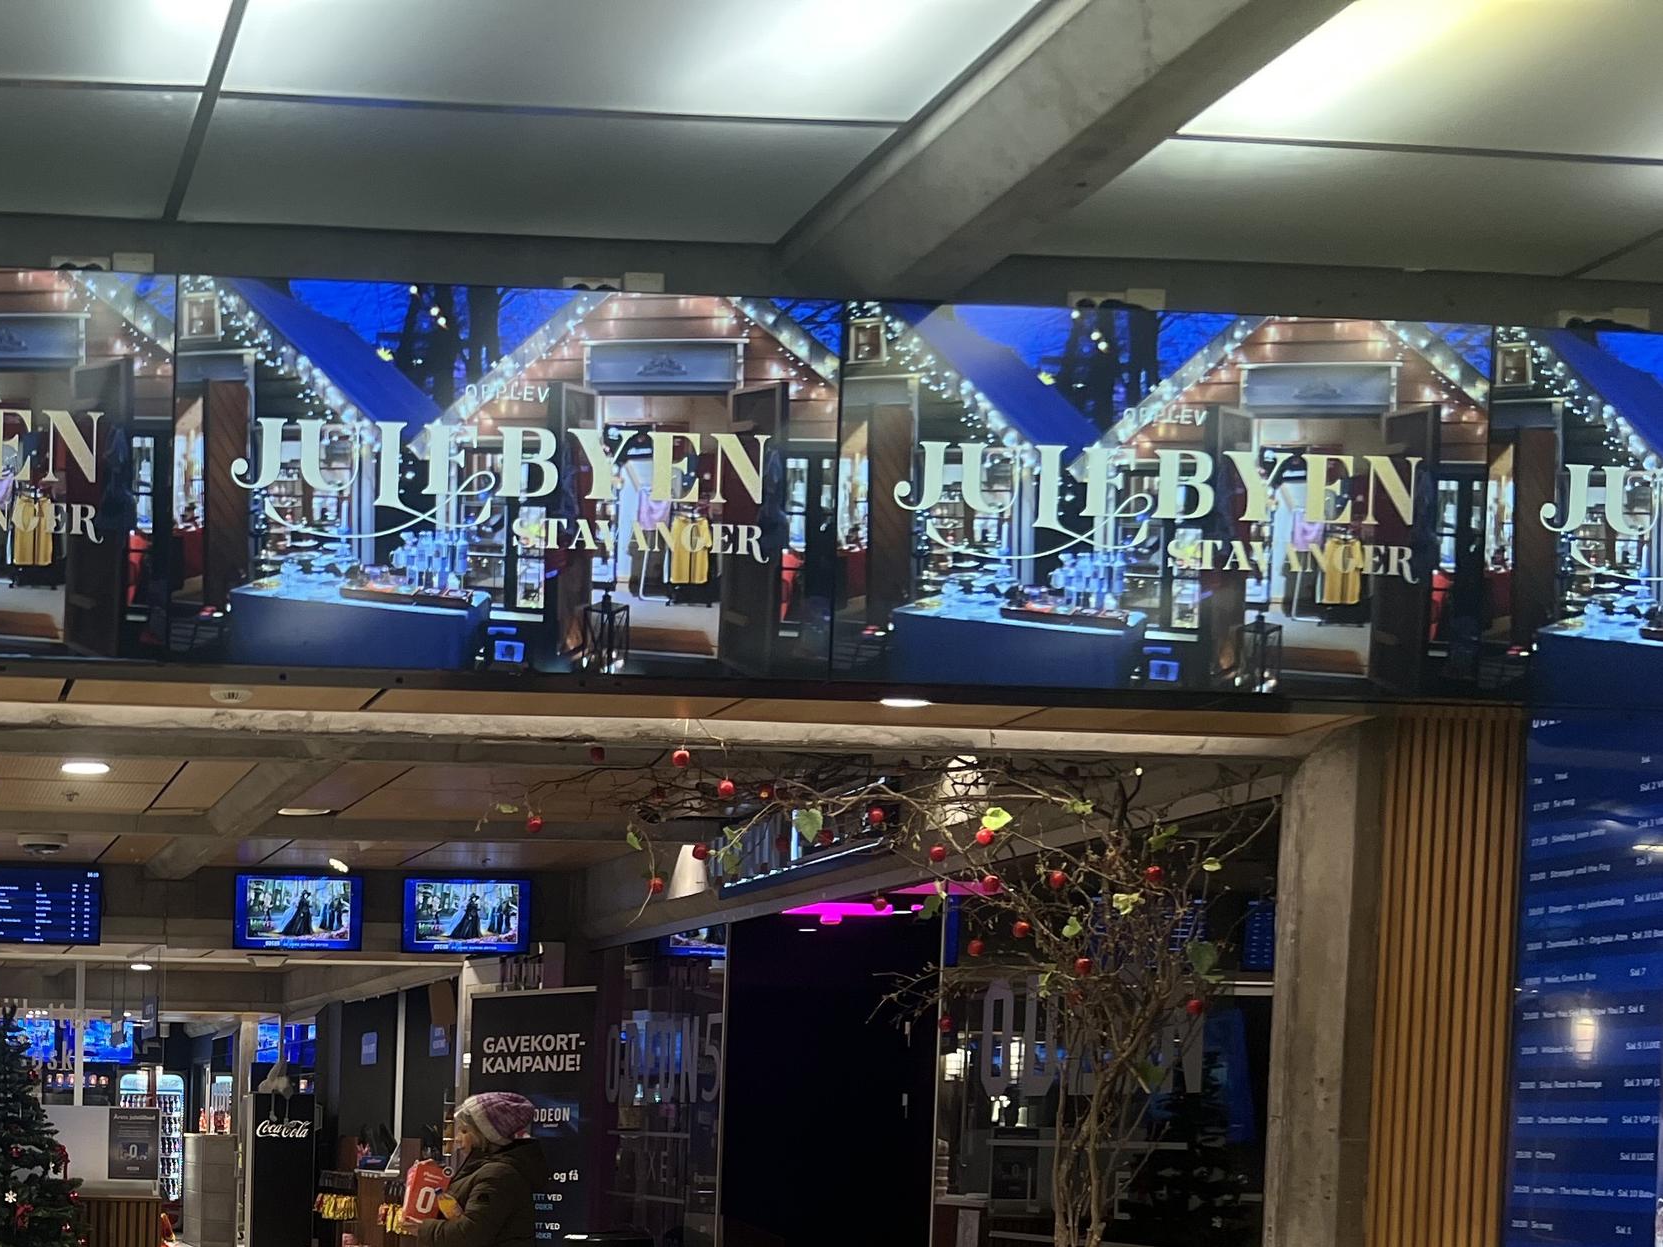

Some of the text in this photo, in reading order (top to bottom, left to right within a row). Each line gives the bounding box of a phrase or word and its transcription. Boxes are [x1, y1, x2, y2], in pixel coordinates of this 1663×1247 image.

[230, 416, 772, 539] JULEBYEN
[894, 440, 1426, 560] JULEBYEN
[1540, 464, 1663, 581] JU
[512, 517, 769, 563] STAVANGER
[1166, 538, 1419, 585] STAVANGER
[482, 1033, 586, 1054] GAVEKORT-
[481, 1054, 581, 1074] KAMPANJE!
[553, 1169, 579, 1182] og få
[547, 1194, 563, 1202] VED
[544, 1223, 561, 1231] VED
